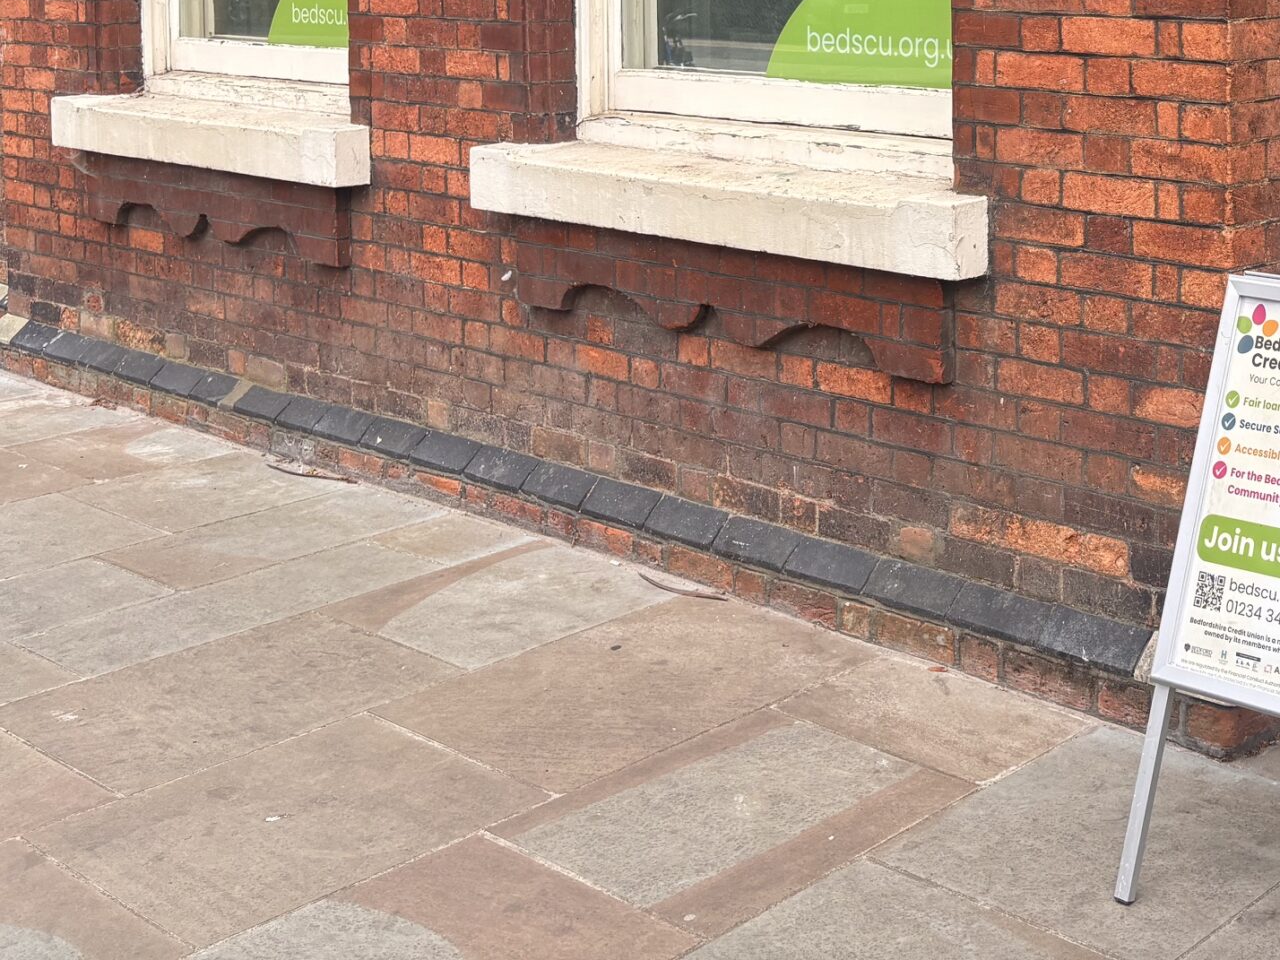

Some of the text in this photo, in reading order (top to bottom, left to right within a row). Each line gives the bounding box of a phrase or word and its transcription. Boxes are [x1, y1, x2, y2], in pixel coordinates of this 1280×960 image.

[1249, 373, 1268, 385] Your
[1243, 397, 1261, 409] Fair
[1239, 419, 1272, 435] Secure
[1230, 467, 1246, 480] For
[1247, 470, 1263, 483] the
[1204, 525, 1255, 558] Join
[1226, 599, 1262, 620] 01234
[1190, 616, 1226, 632] Bedfordshire
[1228, 626, 1246, 637] Credit
[1247, 631, 1264, 641] Union
[1266, 634, 1271, 643] is
[1204, 630, 1224, 640] owned
[1225, 633, 1232, 643] by
[1233, 635, 1241, 644] its
[1242, 639, 1272, 652] members
